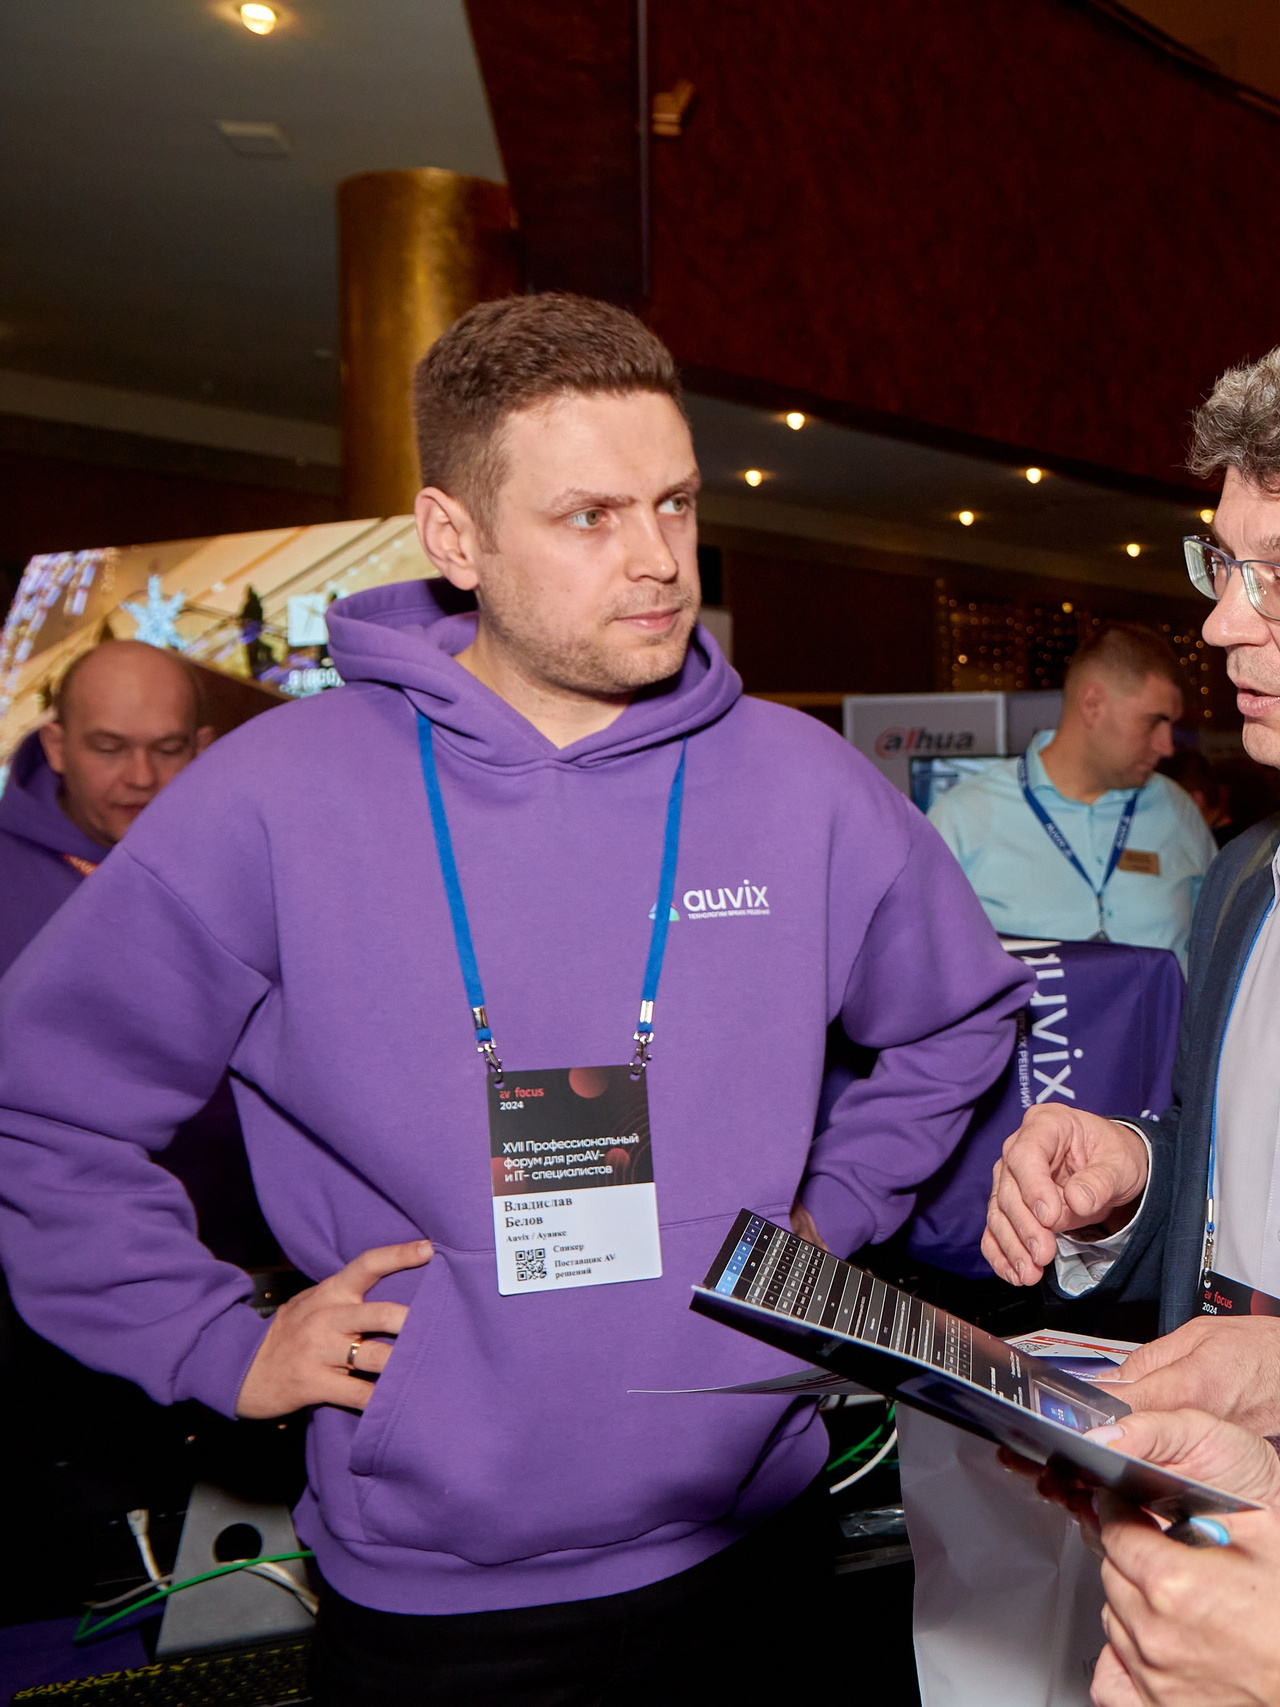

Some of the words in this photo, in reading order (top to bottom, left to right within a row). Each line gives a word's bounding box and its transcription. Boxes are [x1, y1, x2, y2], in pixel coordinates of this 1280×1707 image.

[683, 879, 769, 911] auvix
[514, 1086, 545, 1098] focus
[500, 1101, 524, 1111] 2024
[503, 1142, 525, 1154] XVII
[525, 1133, 640, 1152] Профессиональный
[503, 1156, 542, 1170] форум
[543, 1154, 565, 1167] для
[504, 1172, 513, 1183] и
[531, 1165, 613, 1180] специалистов
[504, 1197, 573, 1213] Владислав
[505, 1216, 544, 1229] Белов
[553, 1243, 585, 1253] Спикер
[554, 1256, 602, 1268] Поставщик
[604, 1253, 617, 1262] AV
[555, 1267, 593, 1280] решений
[1214, 1291, 1234, 1309] focus
[1202, 1302, 1218, 1315] 2024
